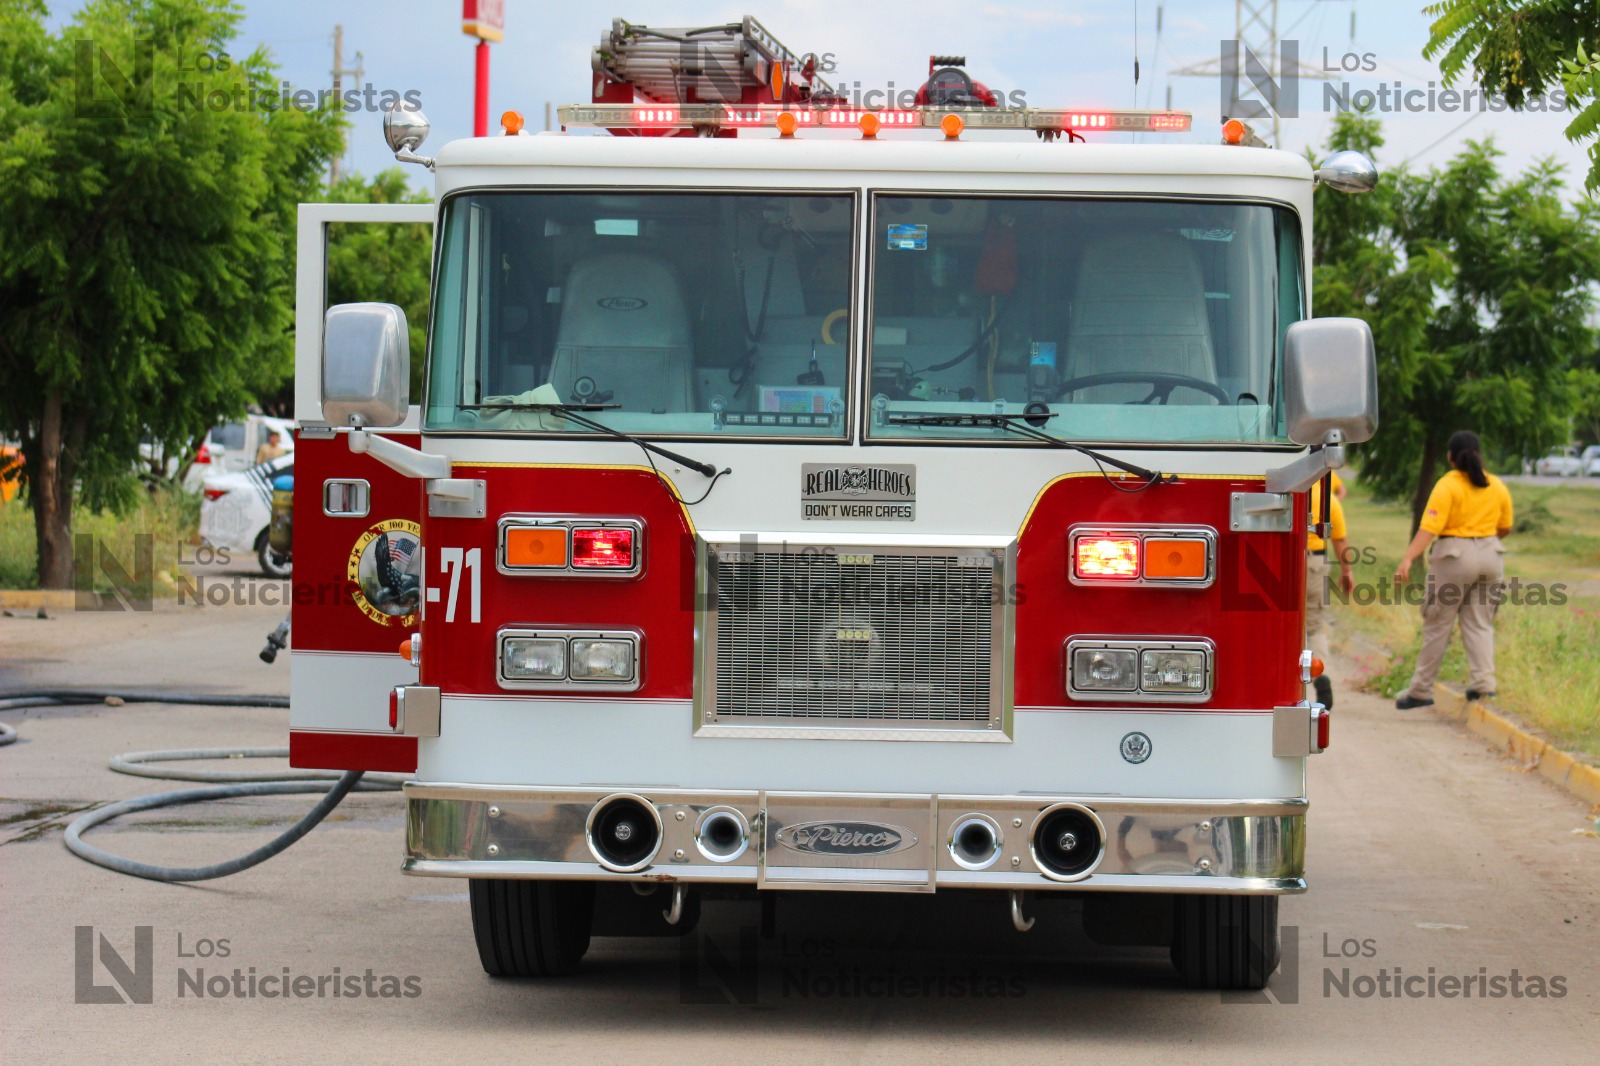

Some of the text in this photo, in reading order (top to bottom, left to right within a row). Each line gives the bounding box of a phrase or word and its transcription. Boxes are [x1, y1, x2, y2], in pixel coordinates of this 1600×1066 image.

[806, 467, 912, 497] REAL HEROES
[805, 504, 912, 518] DON'T WEAR CAPES
[388, 520, 404, 531] 100
[407, 523, 421, 535] YE
[807, 825, 885, 849] Pierce
